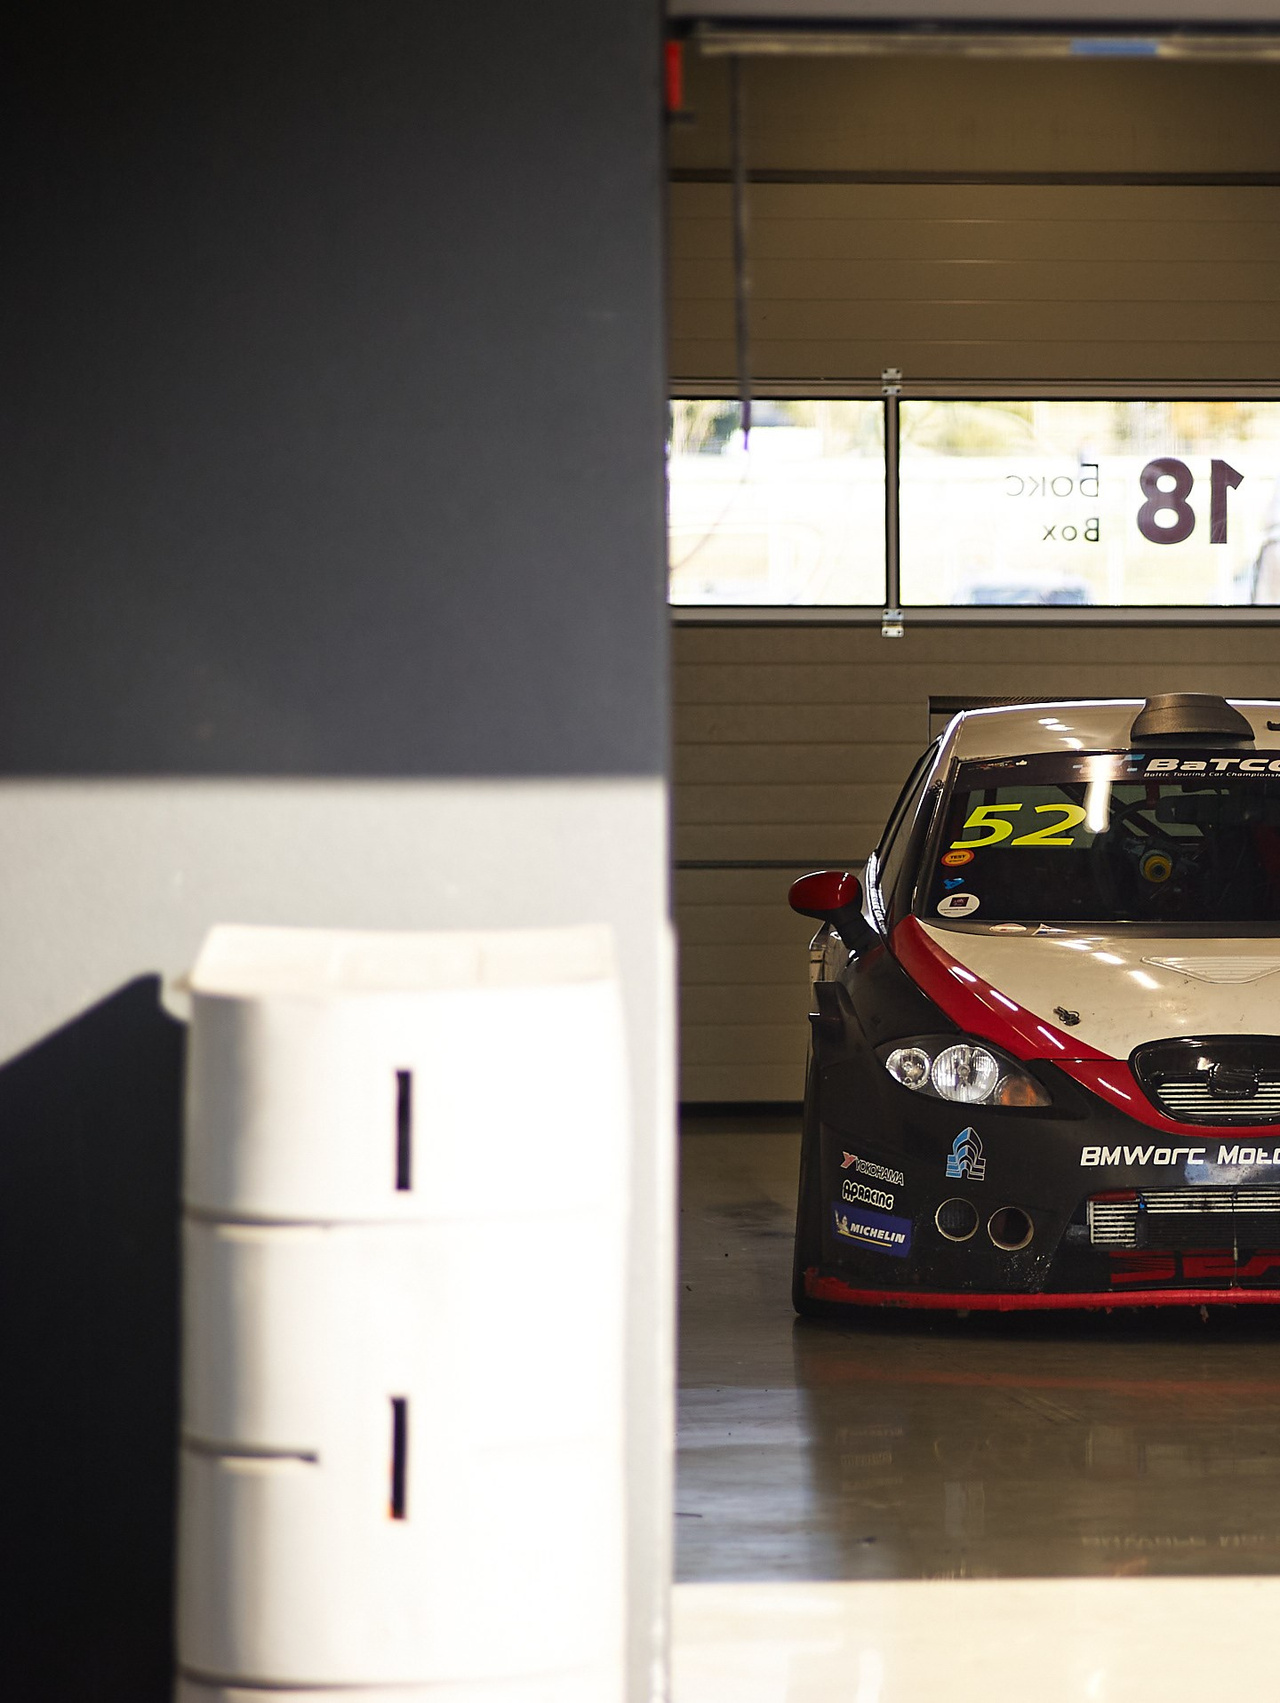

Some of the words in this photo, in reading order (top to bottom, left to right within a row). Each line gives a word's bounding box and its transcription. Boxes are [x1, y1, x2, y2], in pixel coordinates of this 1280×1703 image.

[950, 803, 1087, 849] 52
[1080, 1144, 1207, 1166] BMWorc
[855, 1158, 905, 1187] YOKOHAMA
[850, 1222, 906, 1244] MICHELIN
